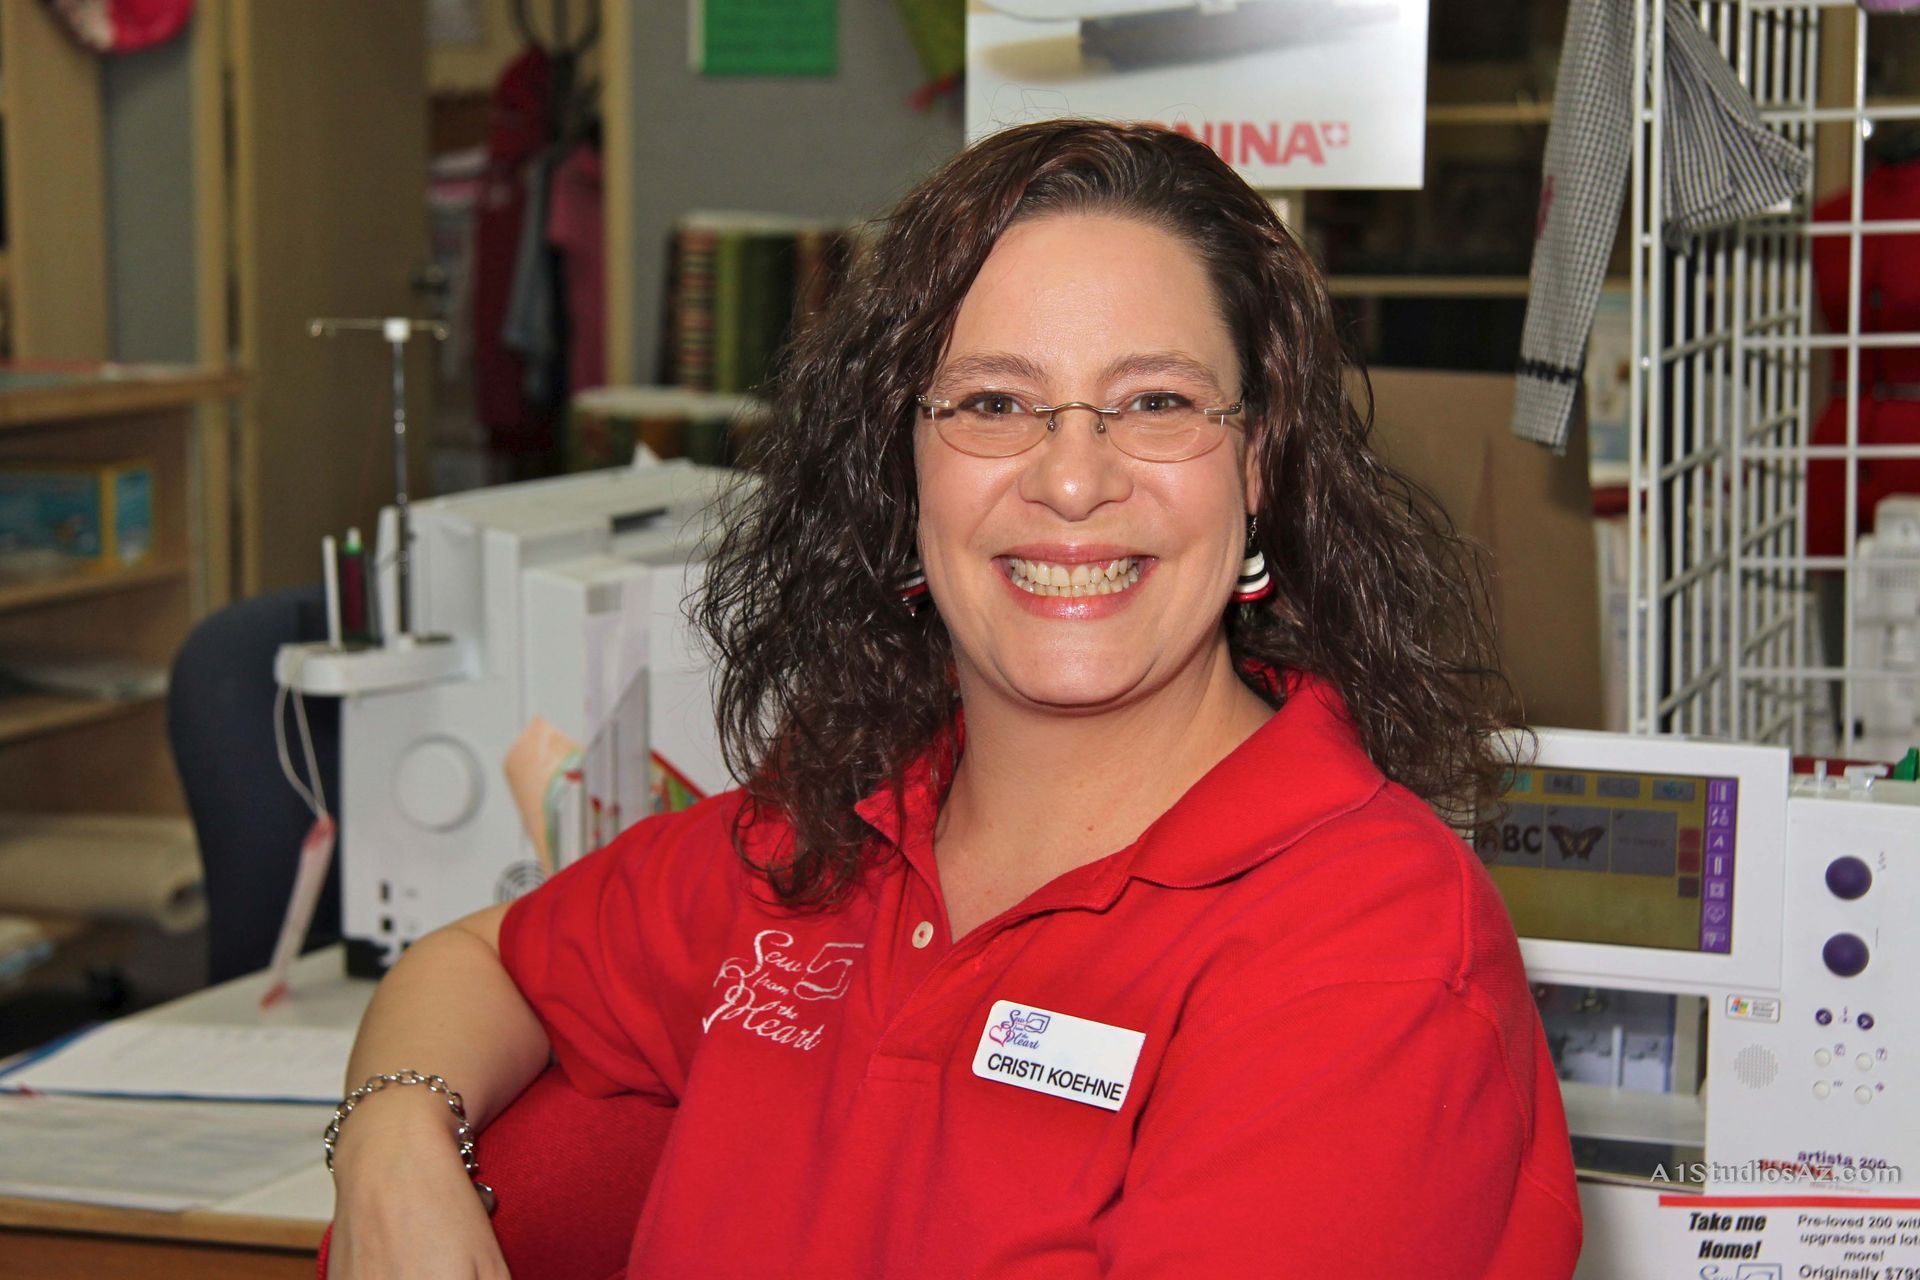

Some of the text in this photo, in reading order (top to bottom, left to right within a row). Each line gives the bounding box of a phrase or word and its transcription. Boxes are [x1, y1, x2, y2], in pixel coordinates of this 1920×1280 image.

[1110, 120, 1328, 166] NINA
[987, 1053, 1124, 1102] CRISTI KOEHNE
[1798, 1150, 1887, 1169] artista 200
[1689, 1212, 1767, 1231] Take me
[1798, 1214, 1864, 1228] Pre-loved
[1868, 1216, 1892, 1228] 200
[1800, 1232, 1920, 1246] upgrades and lot
[1698, 1239, 1762, 1260] Home!
[1843, 1250, 1884, 1262] more!
[1799, 1264, 1880, 1280] Originally
